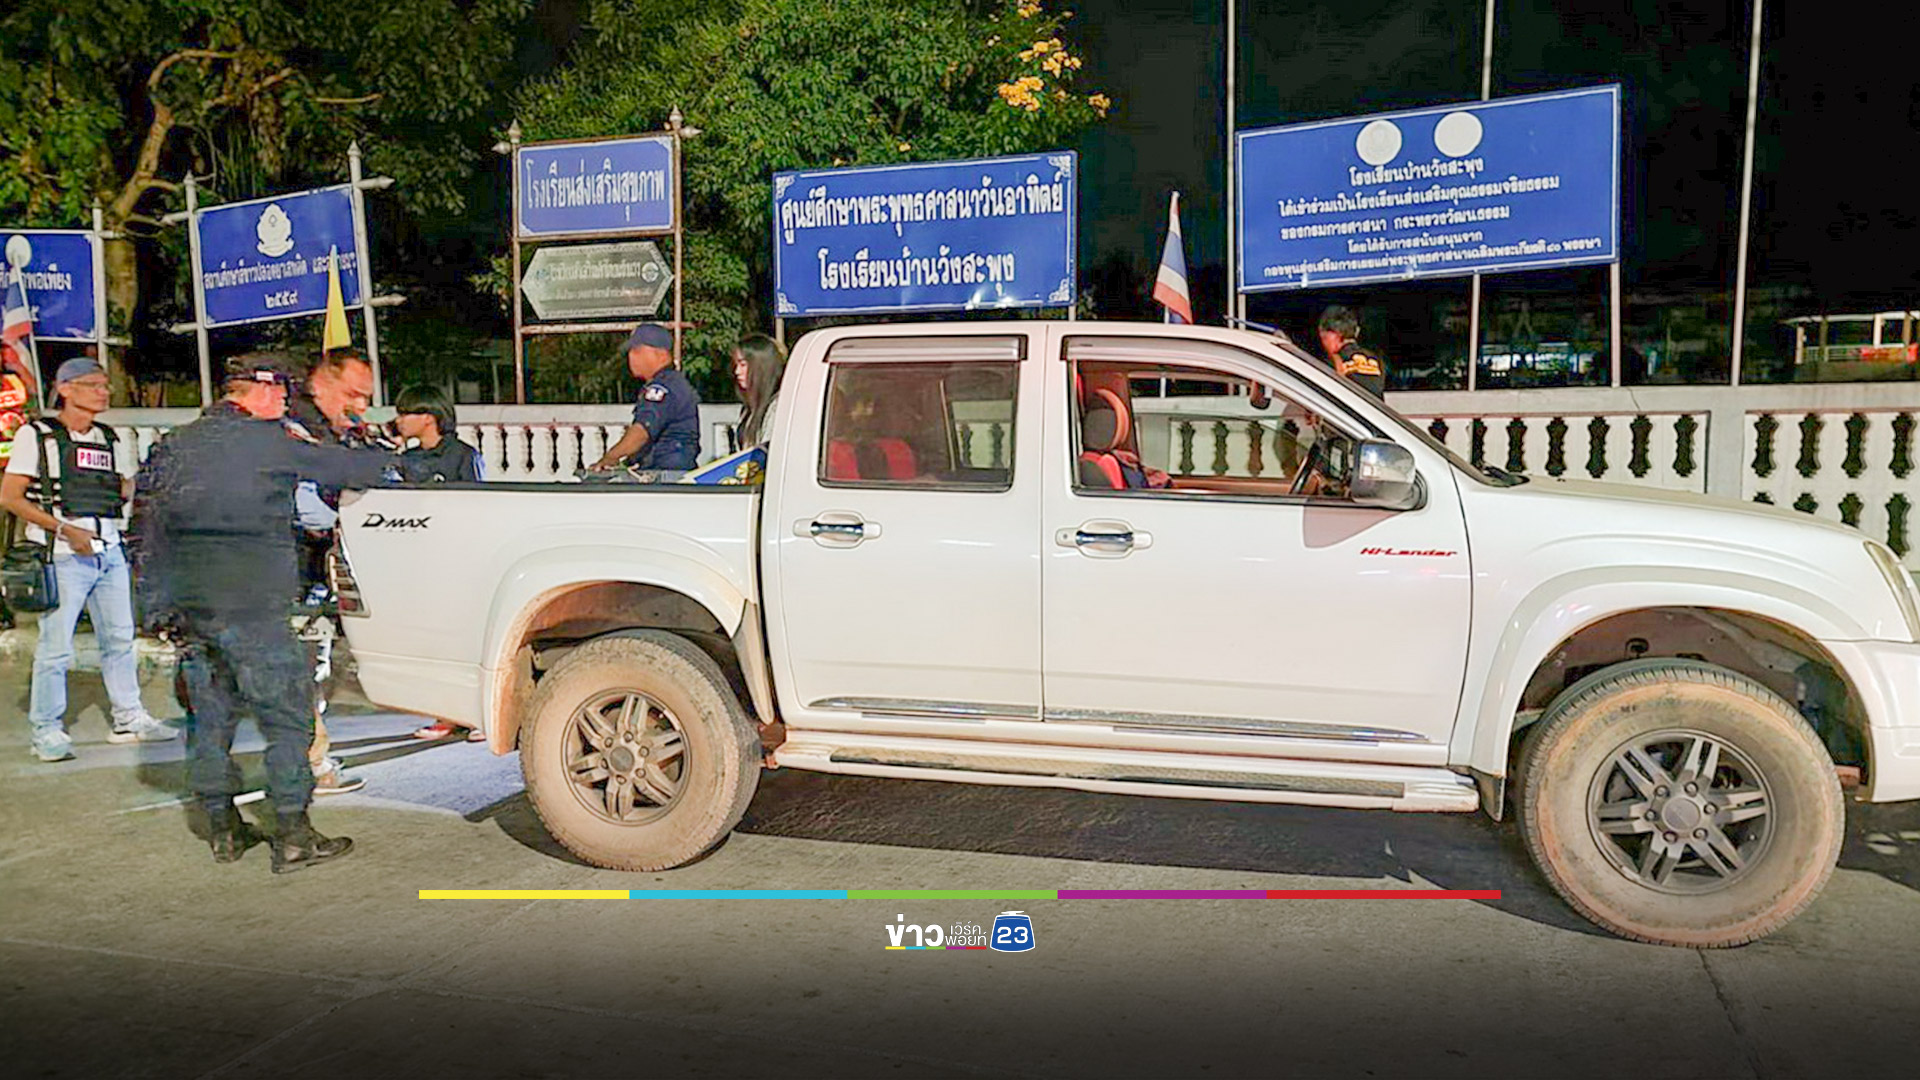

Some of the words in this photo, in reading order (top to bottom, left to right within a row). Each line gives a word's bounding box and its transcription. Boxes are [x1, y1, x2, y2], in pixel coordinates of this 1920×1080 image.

[525, 157, 665, 222] โรงเรียนส่งเสริมสุขภาพ
[1349, 157, 1484, 187] โรงเรียนบ้านวังสะพุง
[781, 171, 1063, 244] ศูนย์ศึกษาพระพุทธศาสนาวันอาทิตย์
[1280, 217, 1387, 240] ของกรมการศาสนา
[1393, 205, 1510, 230] กระทรวงวัฒนธรรม
[818, 245, 1015, 296] โรงเรียนบ้านวังสะพุง
[80, 451, 109, 468] POLICE
